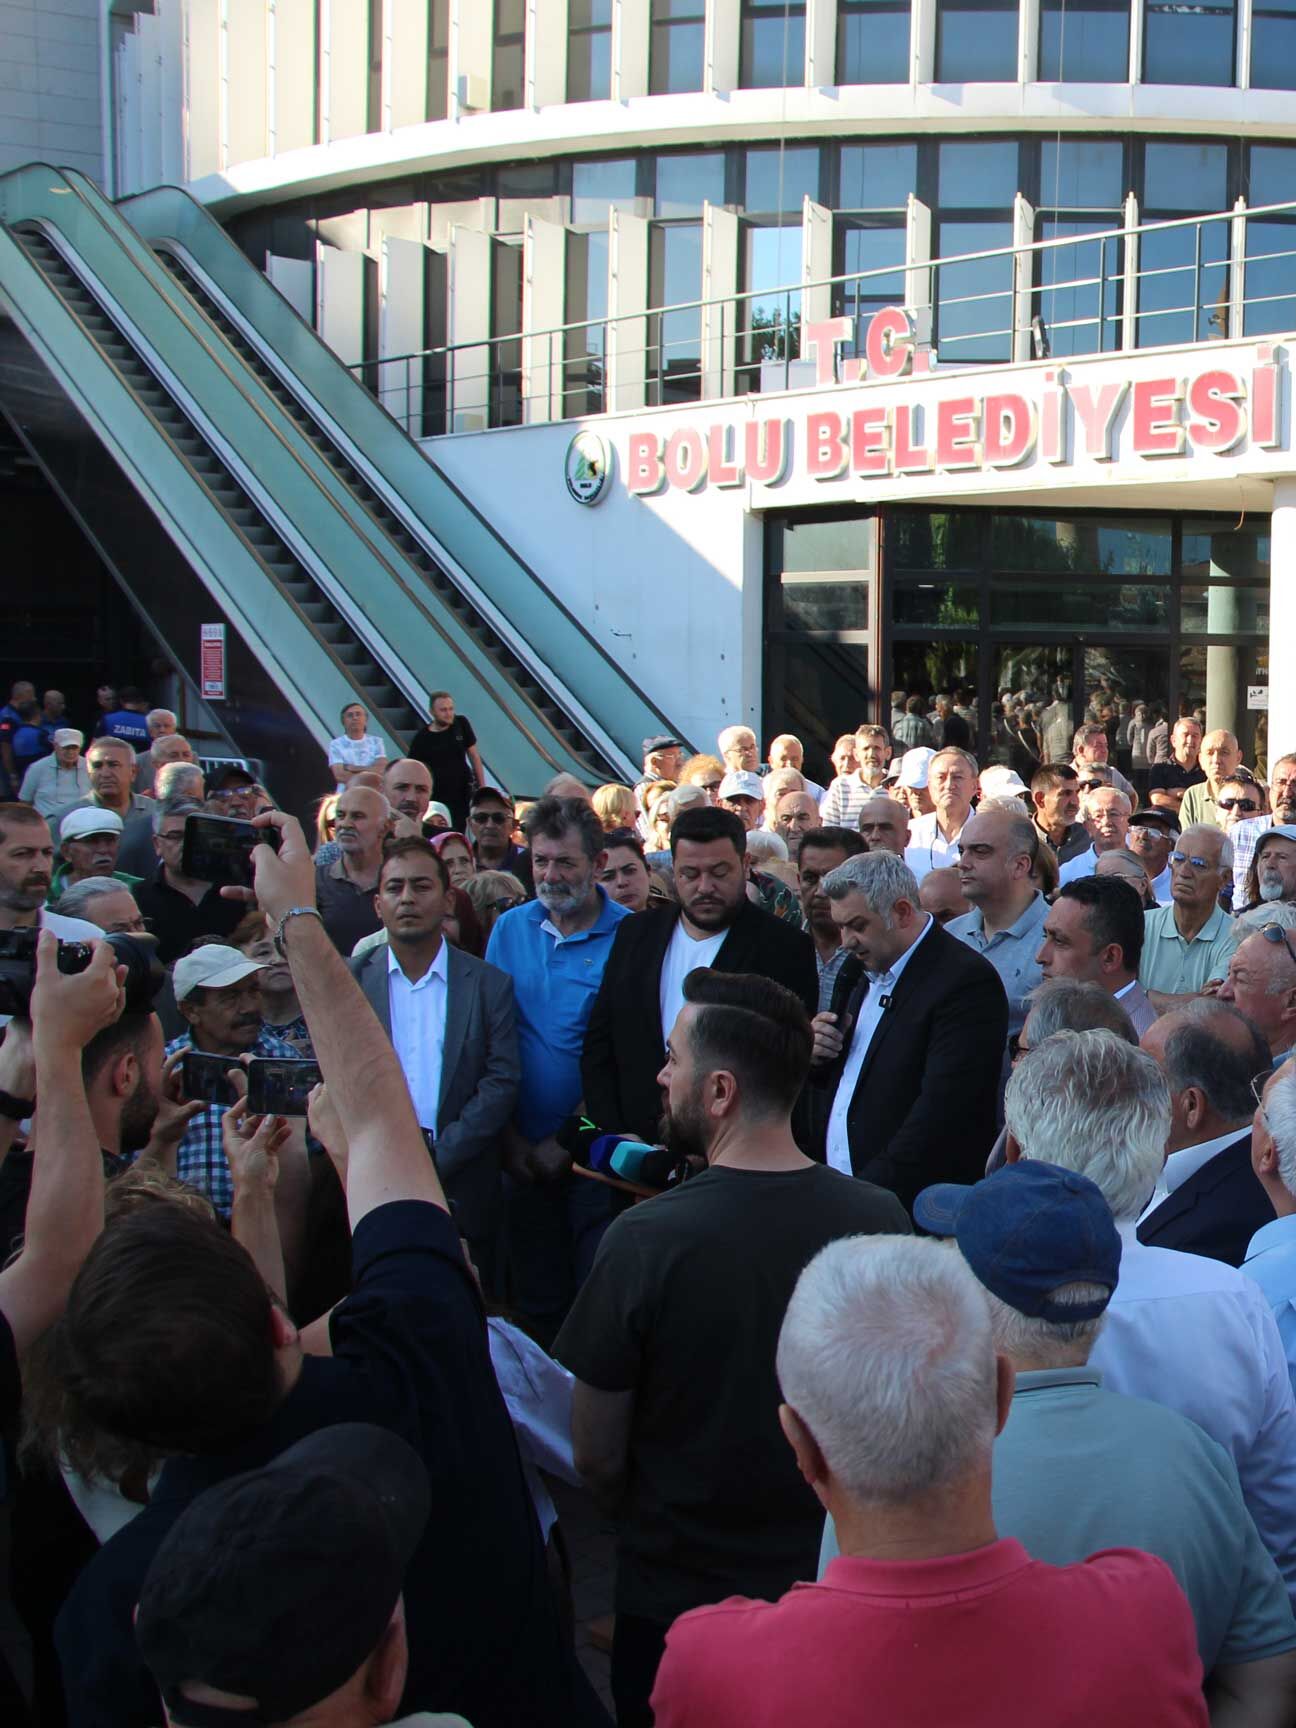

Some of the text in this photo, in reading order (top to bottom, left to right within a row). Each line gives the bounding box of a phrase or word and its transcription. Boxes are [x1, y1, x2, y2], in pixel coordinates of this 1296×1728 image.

[807, 306, 936, 384] T.C.
[628, 344, 1284, 493] BOLU BELEDİYESİ
[113, 724, 146, 737] ZABITA
